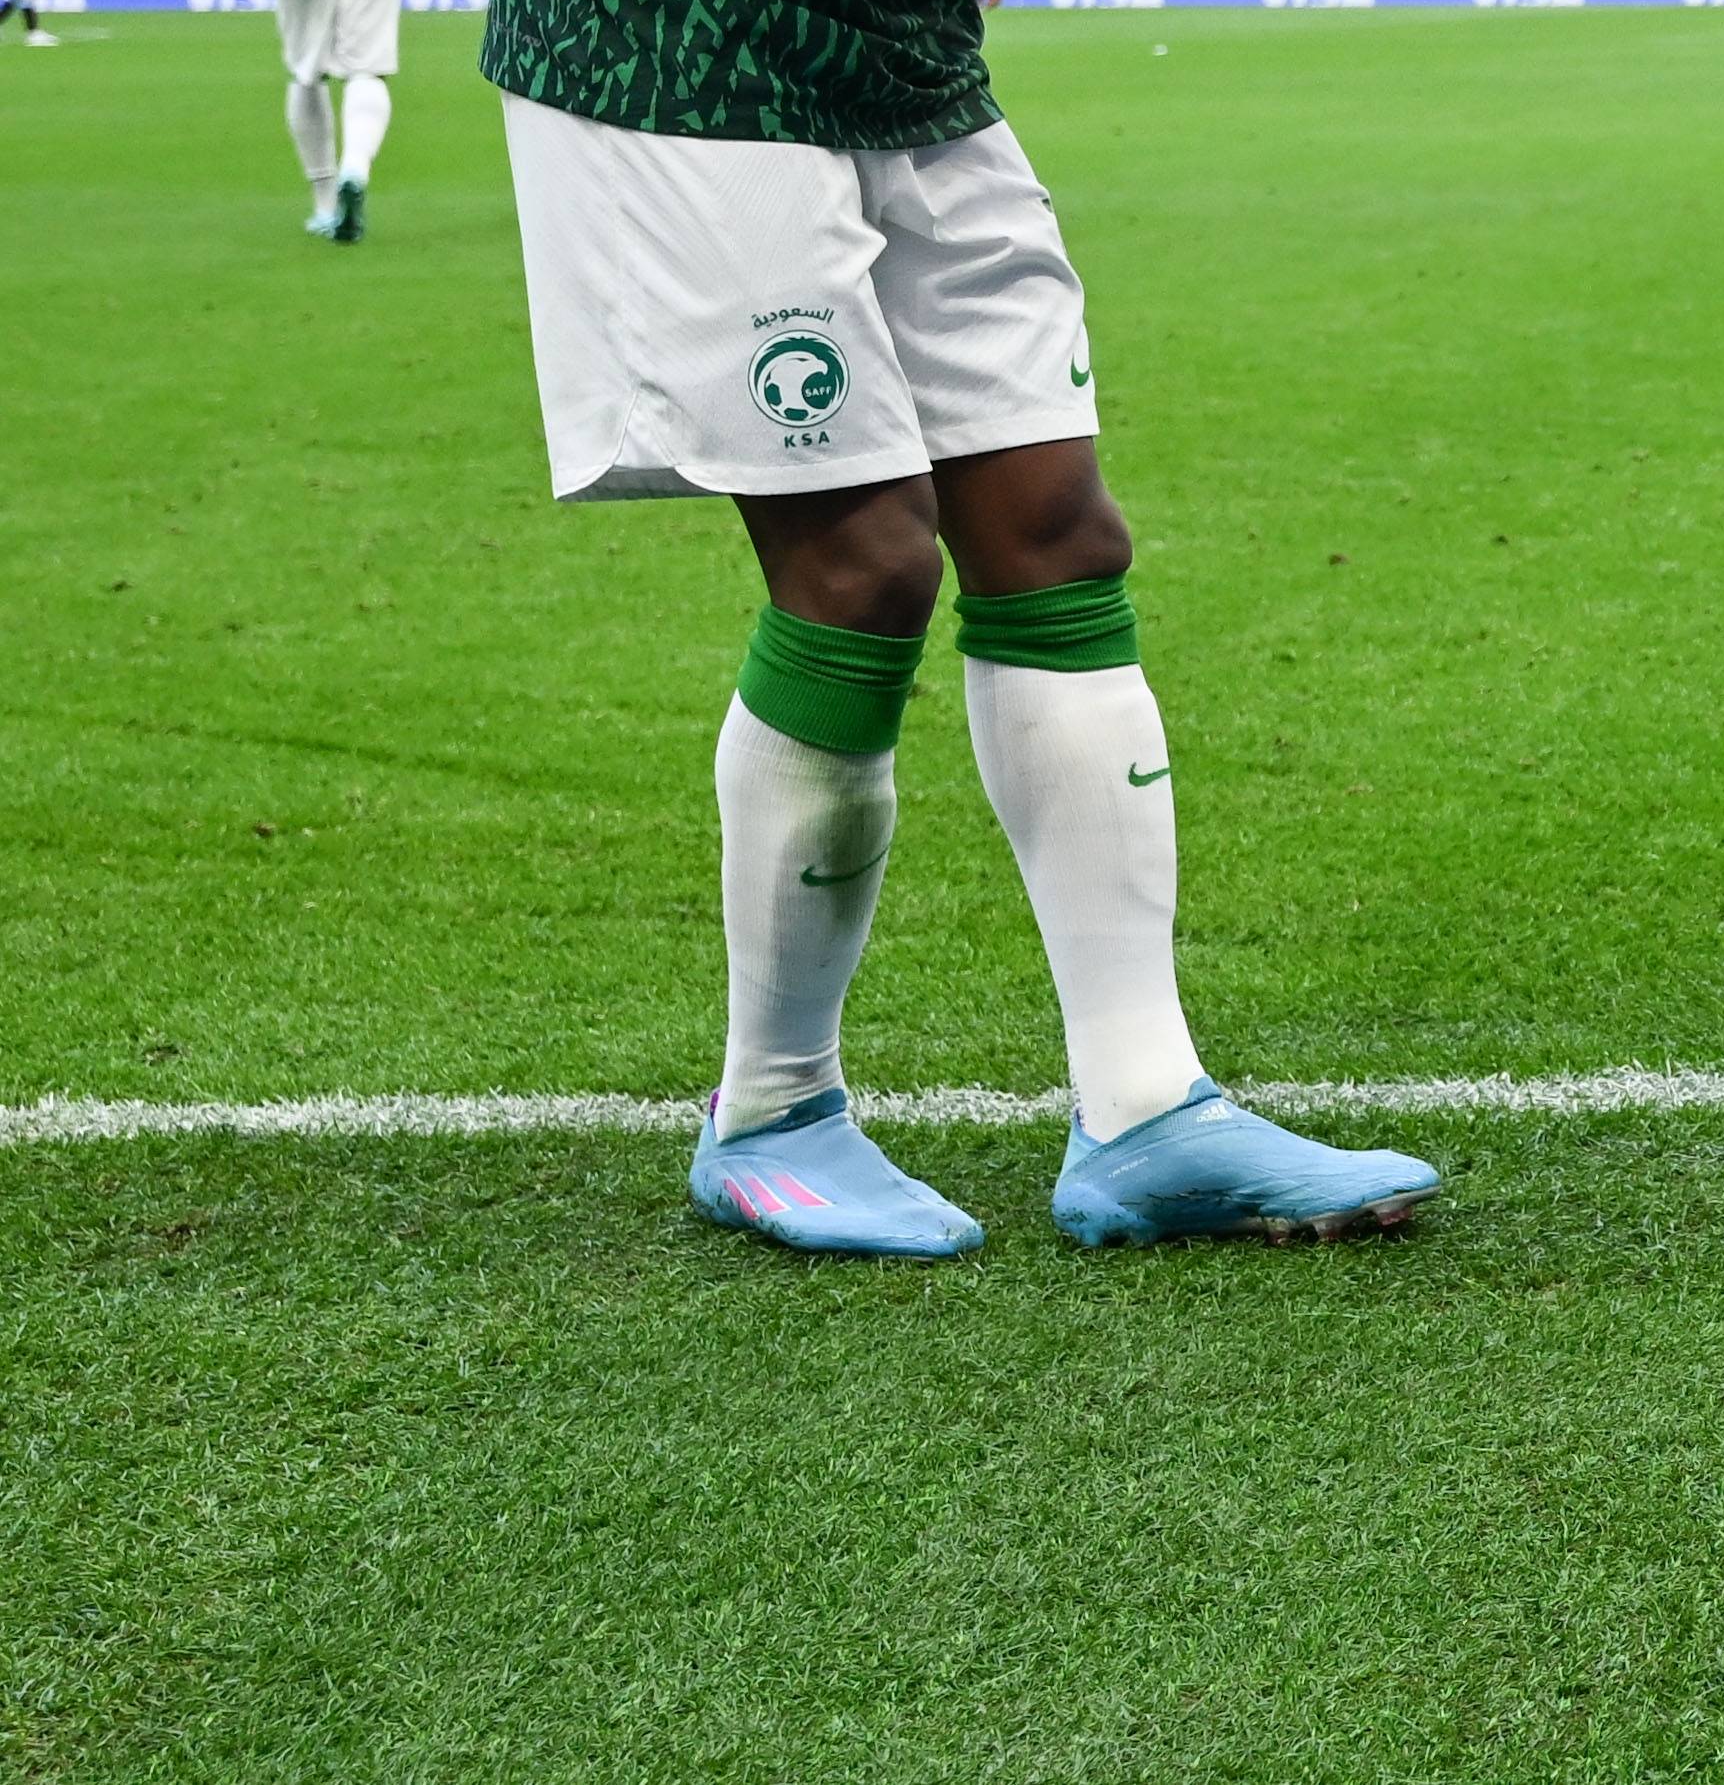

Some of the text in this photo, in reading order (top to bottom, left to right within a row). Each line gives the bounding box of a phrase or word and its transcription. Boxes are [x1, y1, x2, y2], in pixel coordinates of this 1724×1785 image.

[751, 307, 835, 329] السعودية
[804, 386, 832, 398] SAFF
[784, 431, 830, 449] KSA
